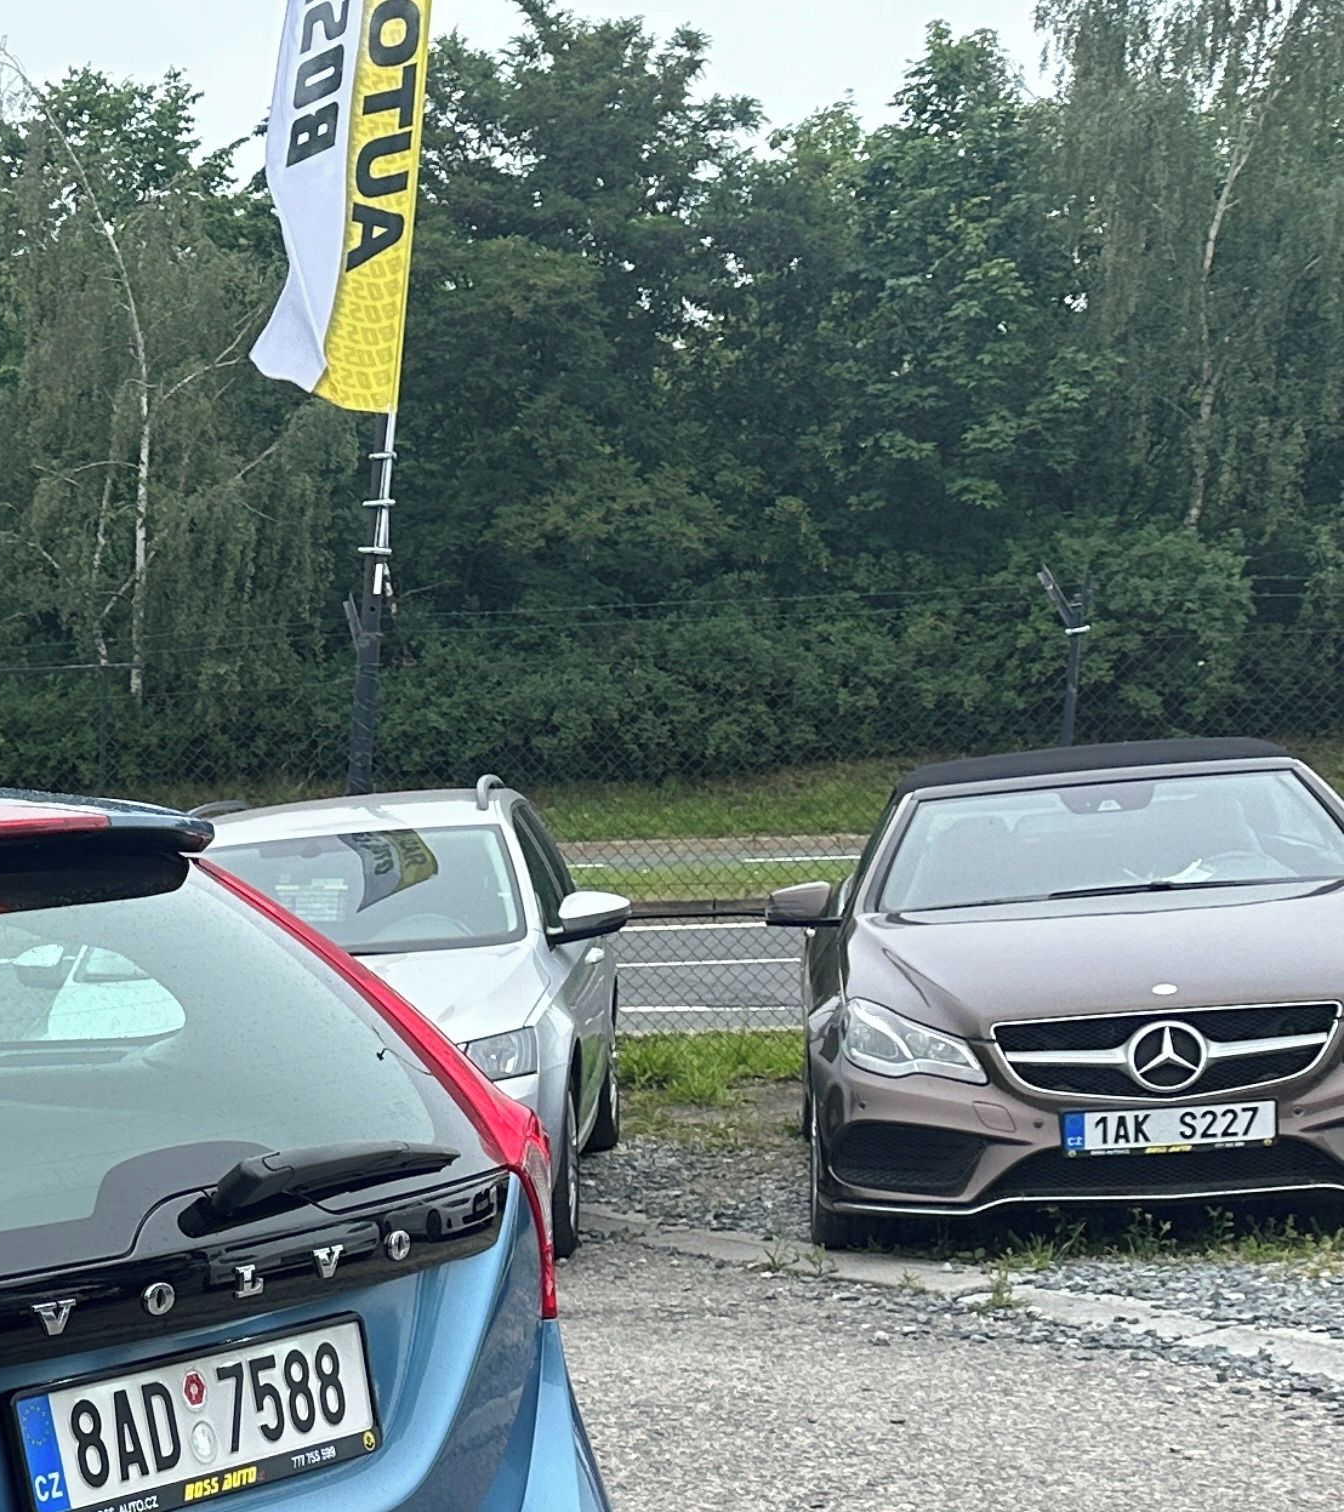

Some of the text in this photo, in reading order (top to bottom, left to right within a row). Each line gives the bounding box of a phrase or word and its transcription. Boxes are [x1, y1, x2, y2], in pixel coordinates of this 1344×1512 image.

[1094, 1106, 1259, 1145] 1AK S227
[30, 1229, 411, 1336] VOLVO
[70, 1341, 346, 1489] 8AD 7588
[34, 1471, 64, 1502] CZ
[184, 1466, 257, 1501] BOSS AUTO
